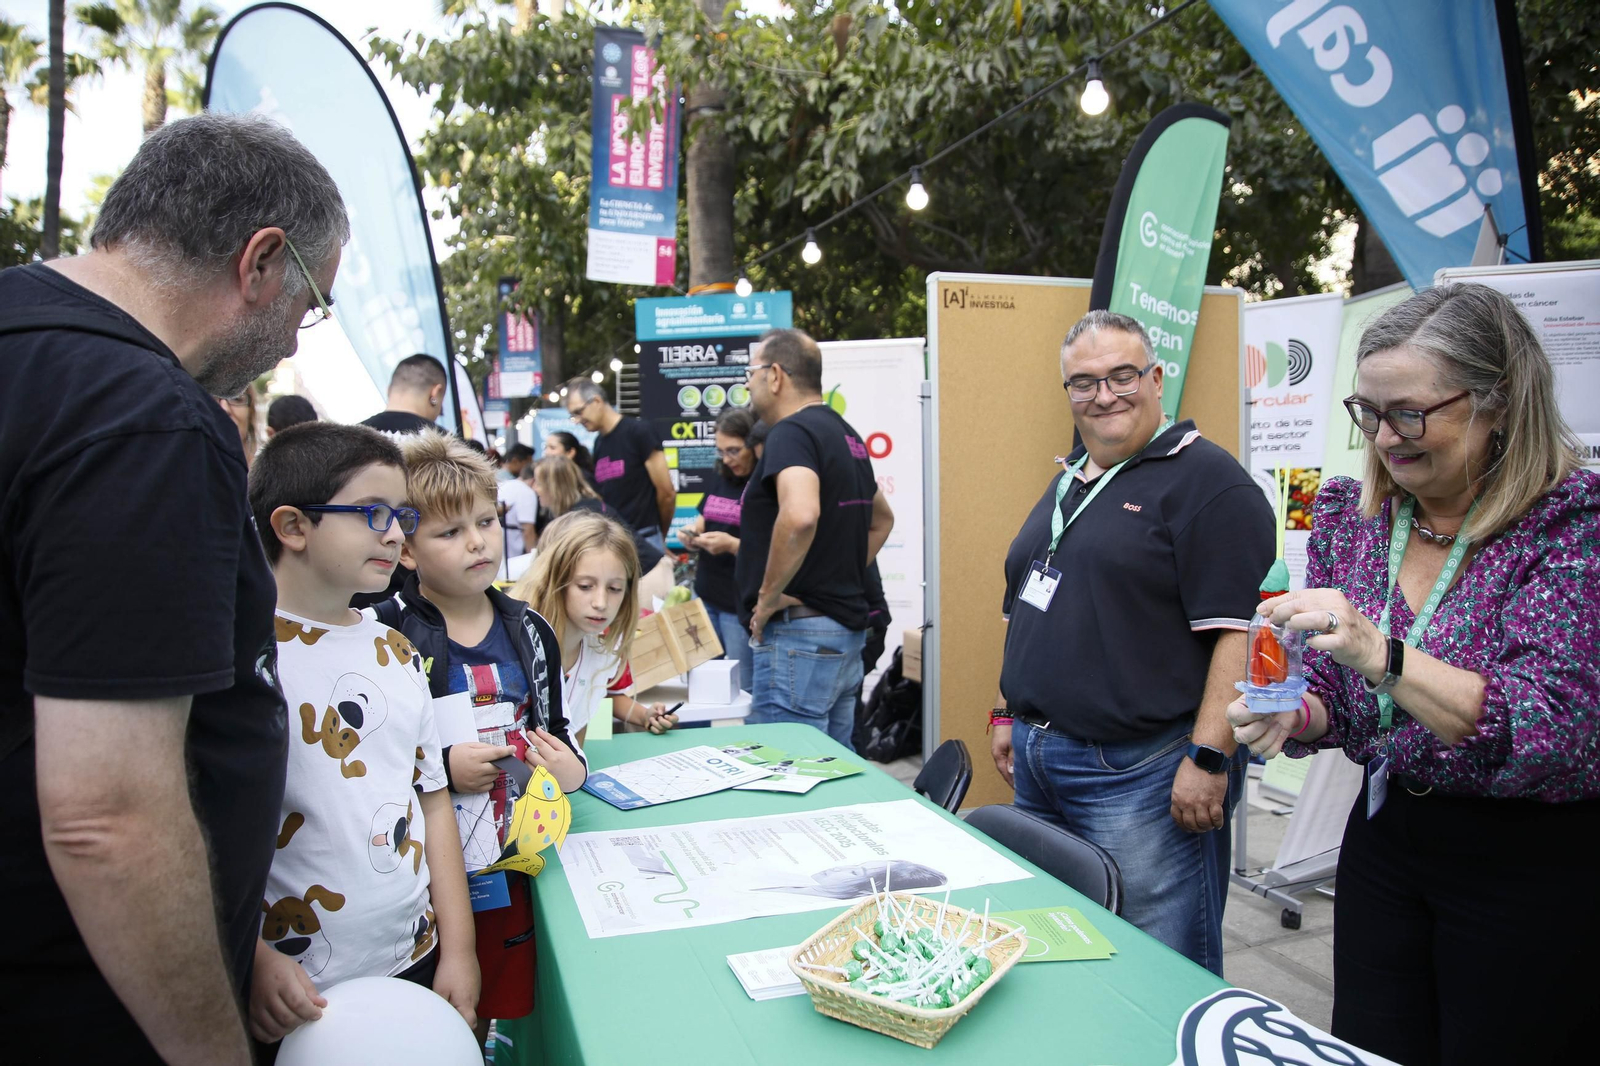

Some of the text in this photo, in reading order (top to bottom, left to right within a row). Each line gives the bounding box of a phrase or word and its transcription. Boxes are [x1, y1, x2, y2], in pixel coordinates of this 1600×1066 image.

[970, 301, 1015, 309] INVESTIGA
[1148, 325, 1183, 351] gan
[657, 344, 719, 363] TIERRA
[1275, 419, 1290, 428] de
[1294, 418, 1313, 426] los
[1267, 431, 1310, 440] sector
[1123, 502, 1142, 512] BOSS
[706, 758, 746, 776] OTRI
